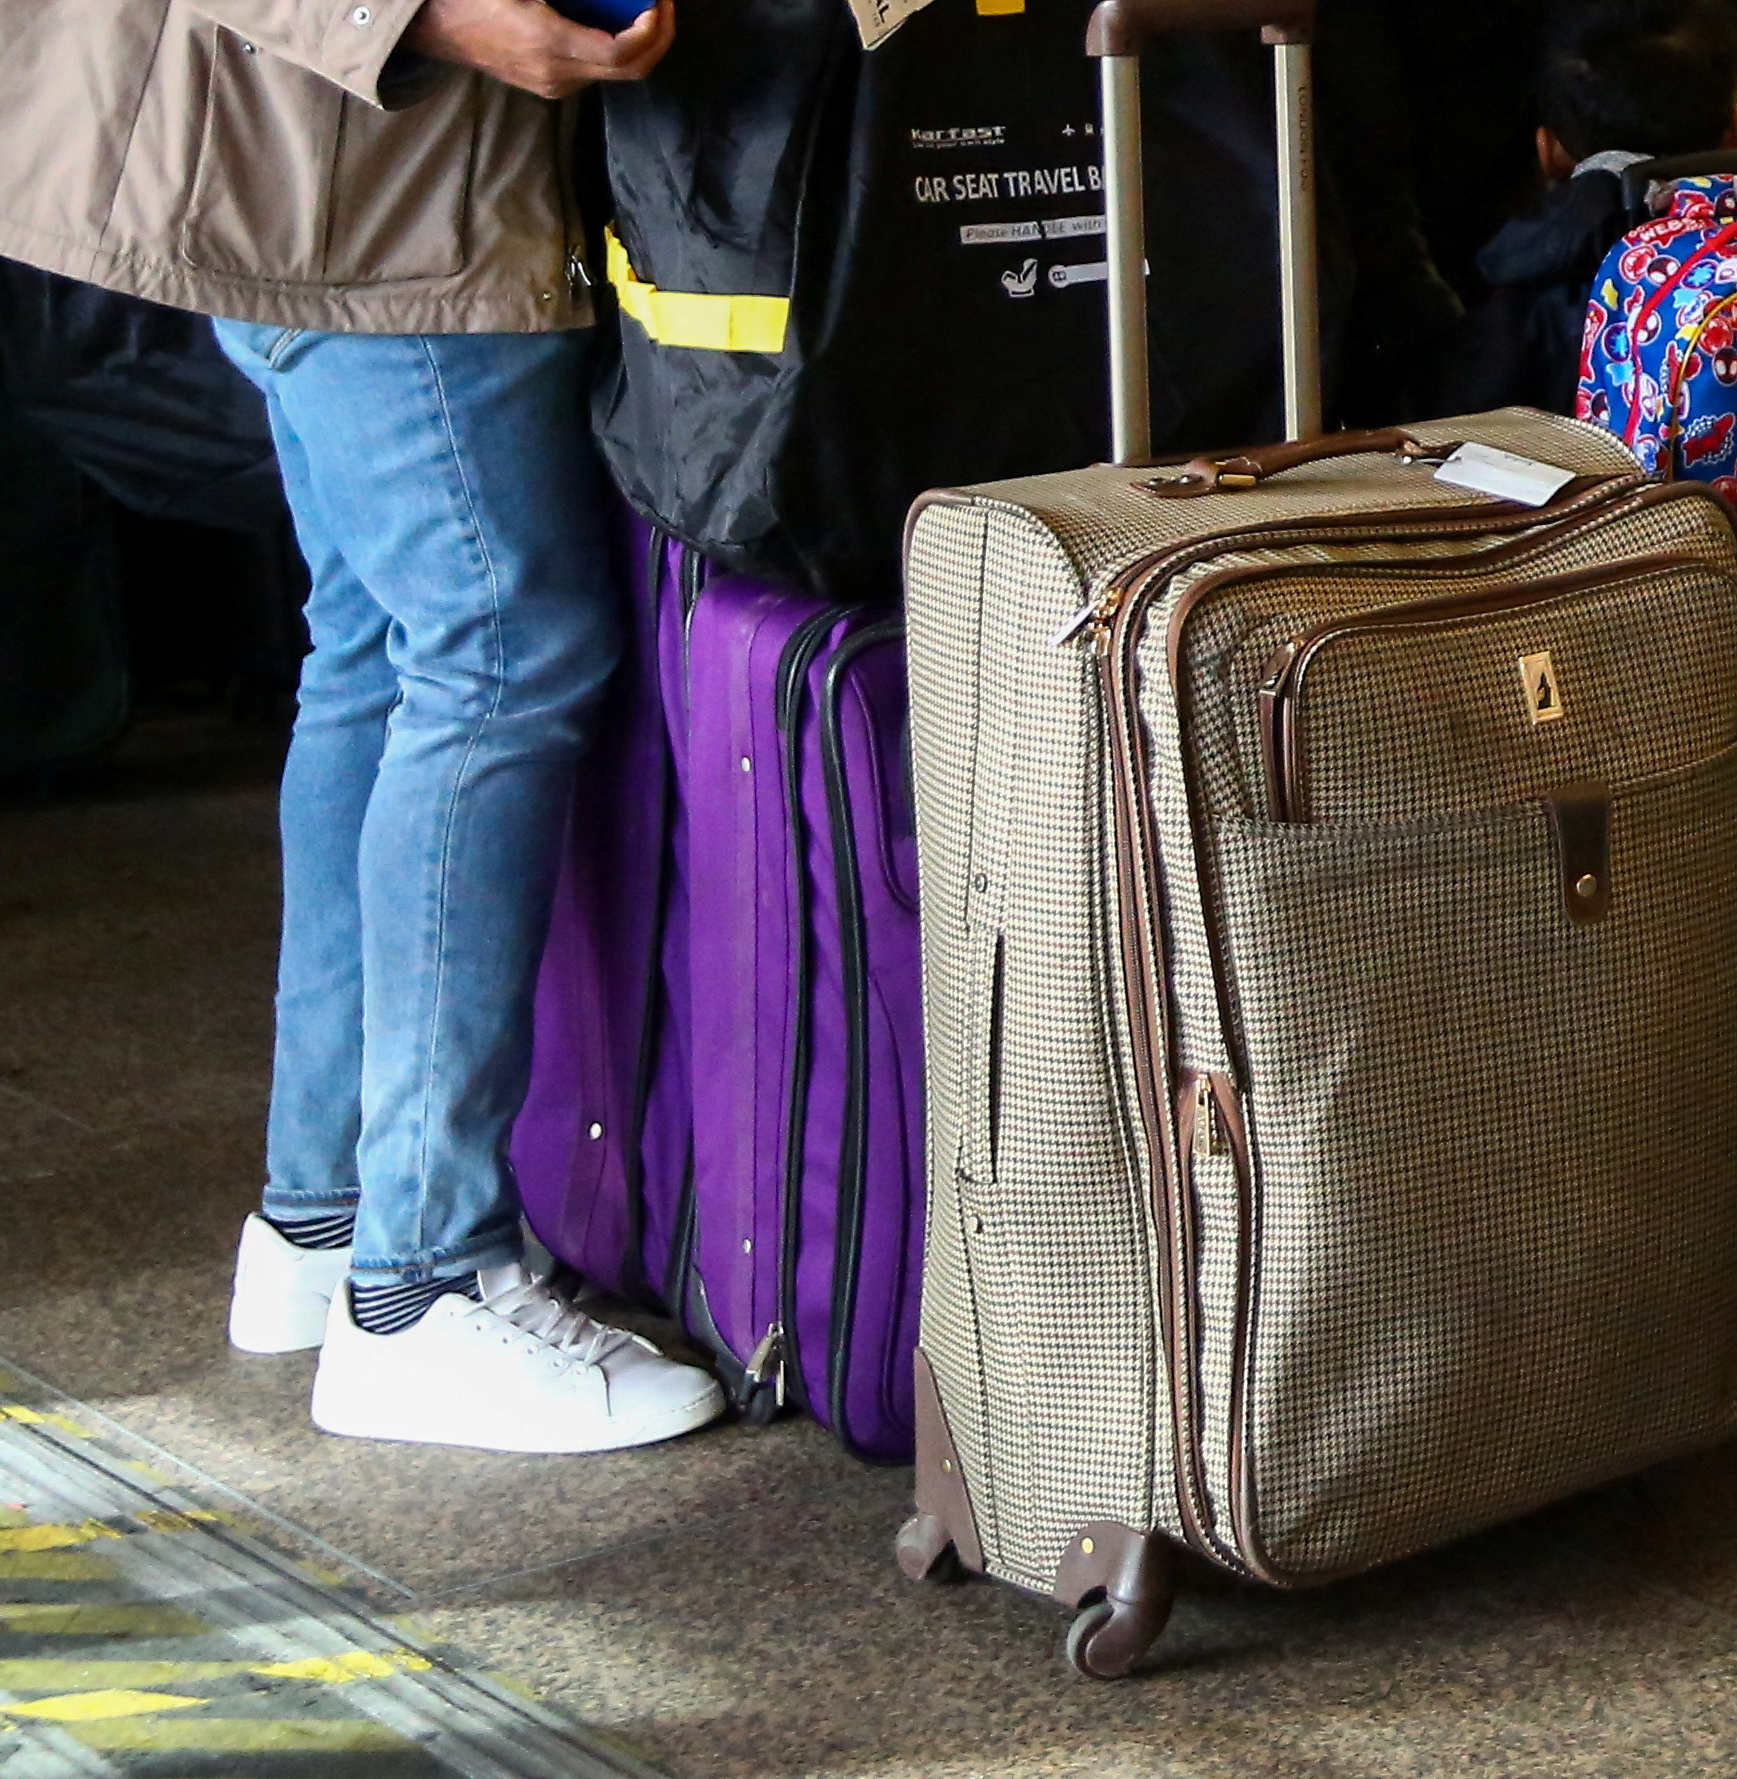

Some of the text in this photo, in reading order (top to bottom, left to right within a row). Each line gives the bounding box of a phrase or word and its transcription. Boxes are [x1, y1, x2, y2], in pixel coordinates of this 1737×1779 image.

[915, 165, 1104, 202] CAR SEAT TRAVEL B
